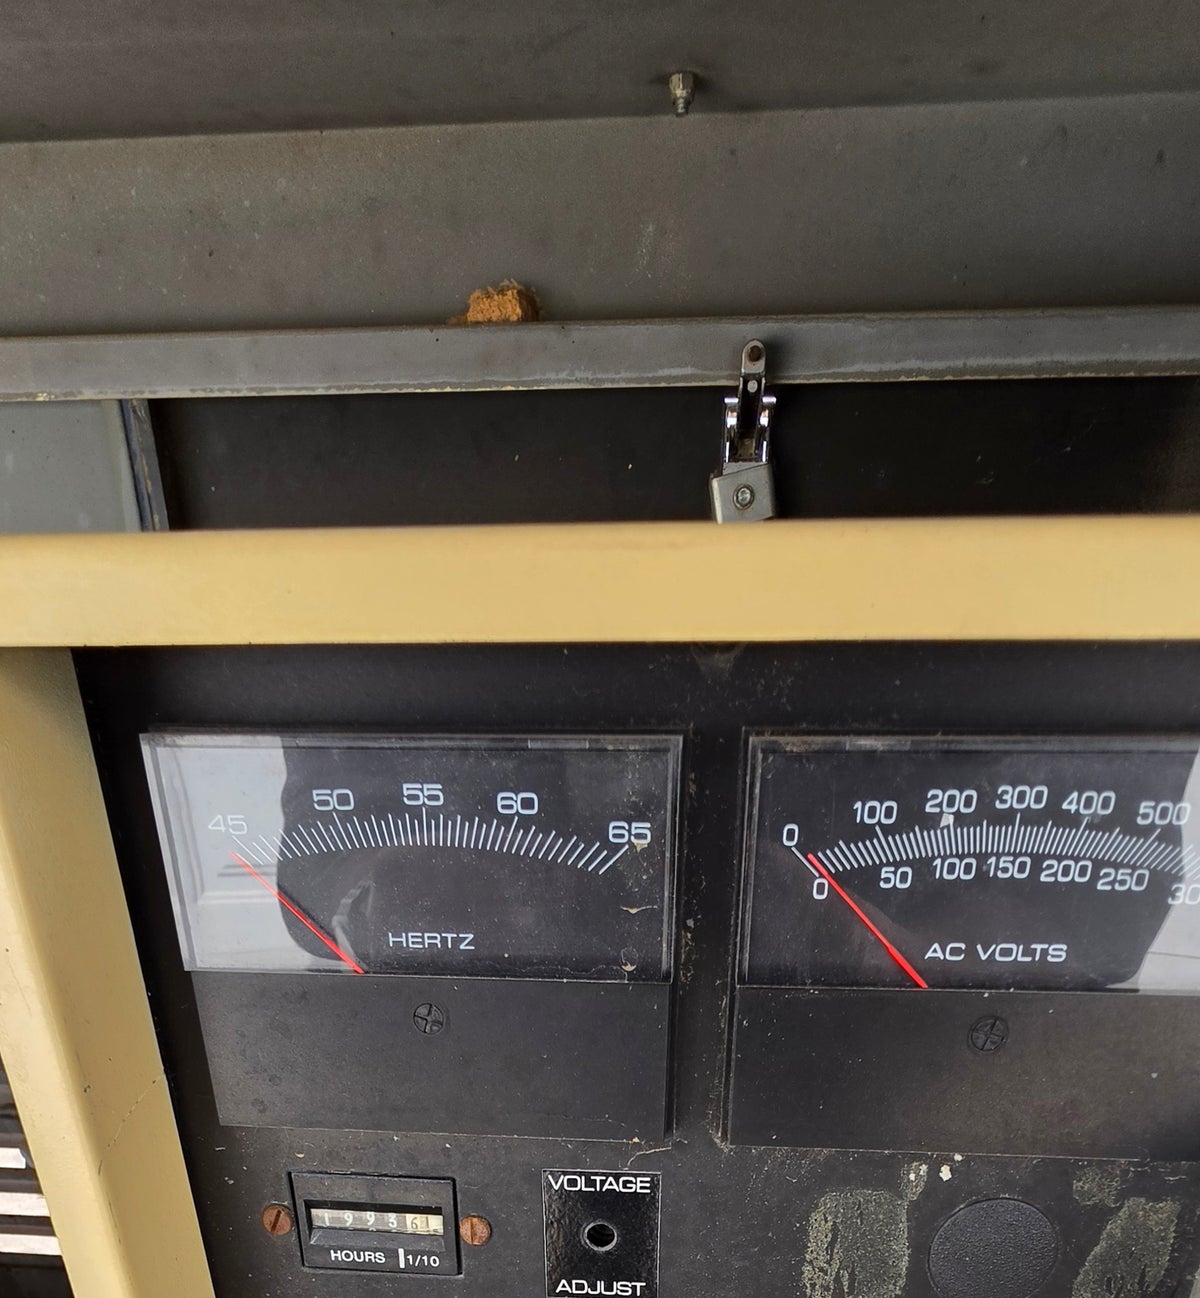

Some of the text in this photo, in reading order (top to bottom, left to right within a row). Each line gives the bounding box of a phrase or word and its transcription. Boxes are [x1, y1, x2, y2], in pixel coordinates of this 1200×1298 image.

[208, 783, 651, 844] 45 50 55 60 65
[782, 785, 1191, 847] 0 100 200 300 400 500
[813, 877, 829, 900] 0
[880, 866, 912, 889] 50
[932, 858, 977, 880] 100
[987, 856, 1031, 879] 150
[1040, 860, 1093, 882] 200
[1097, 868, 1150, 891] 250
[388, 932, 475, 950] HERTZ
[924, 943, 1067, 962] AC VOLTS
[548, 1175, 651, 1193] VOLTAGE
[330, 1249, 440, 1267] HOURS 1/10
[555, 1279, 646, 1297] ADJUST
